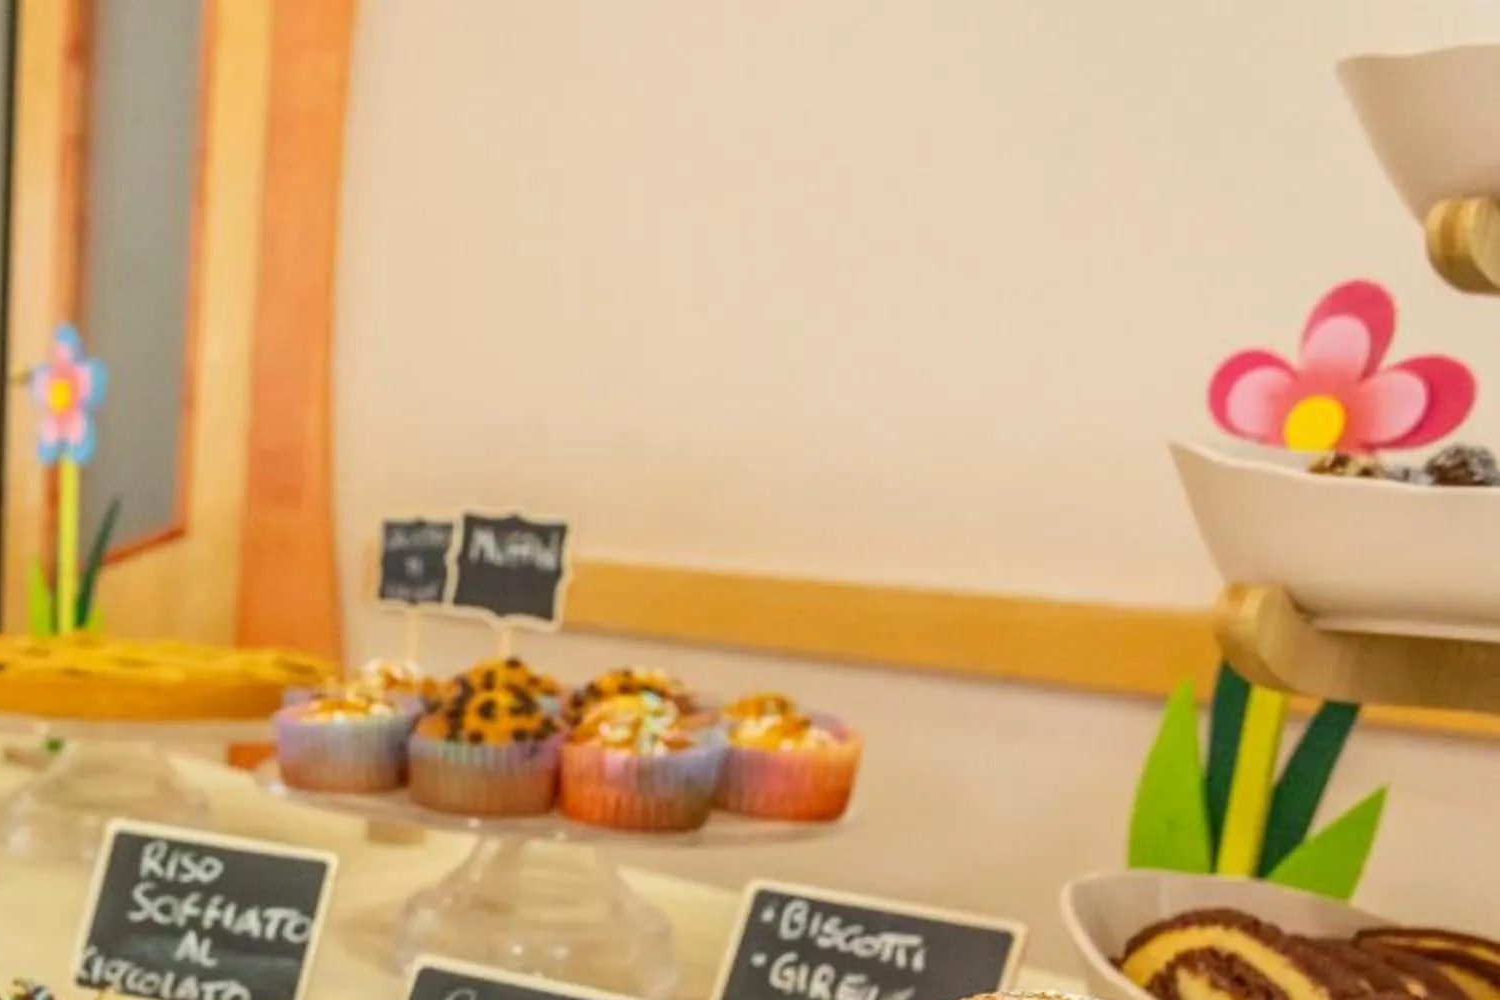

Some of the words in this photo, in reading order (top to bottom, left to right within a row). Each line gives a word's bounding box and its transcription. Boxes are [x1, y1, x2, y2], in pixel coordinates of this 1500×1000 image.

[139, 840, 224, 884] RISO
[127, 881, 314, 943] SOFFIATO
[778, 899, 926, 973] BISCOTTI
[174, 930, 218, 967] AL
